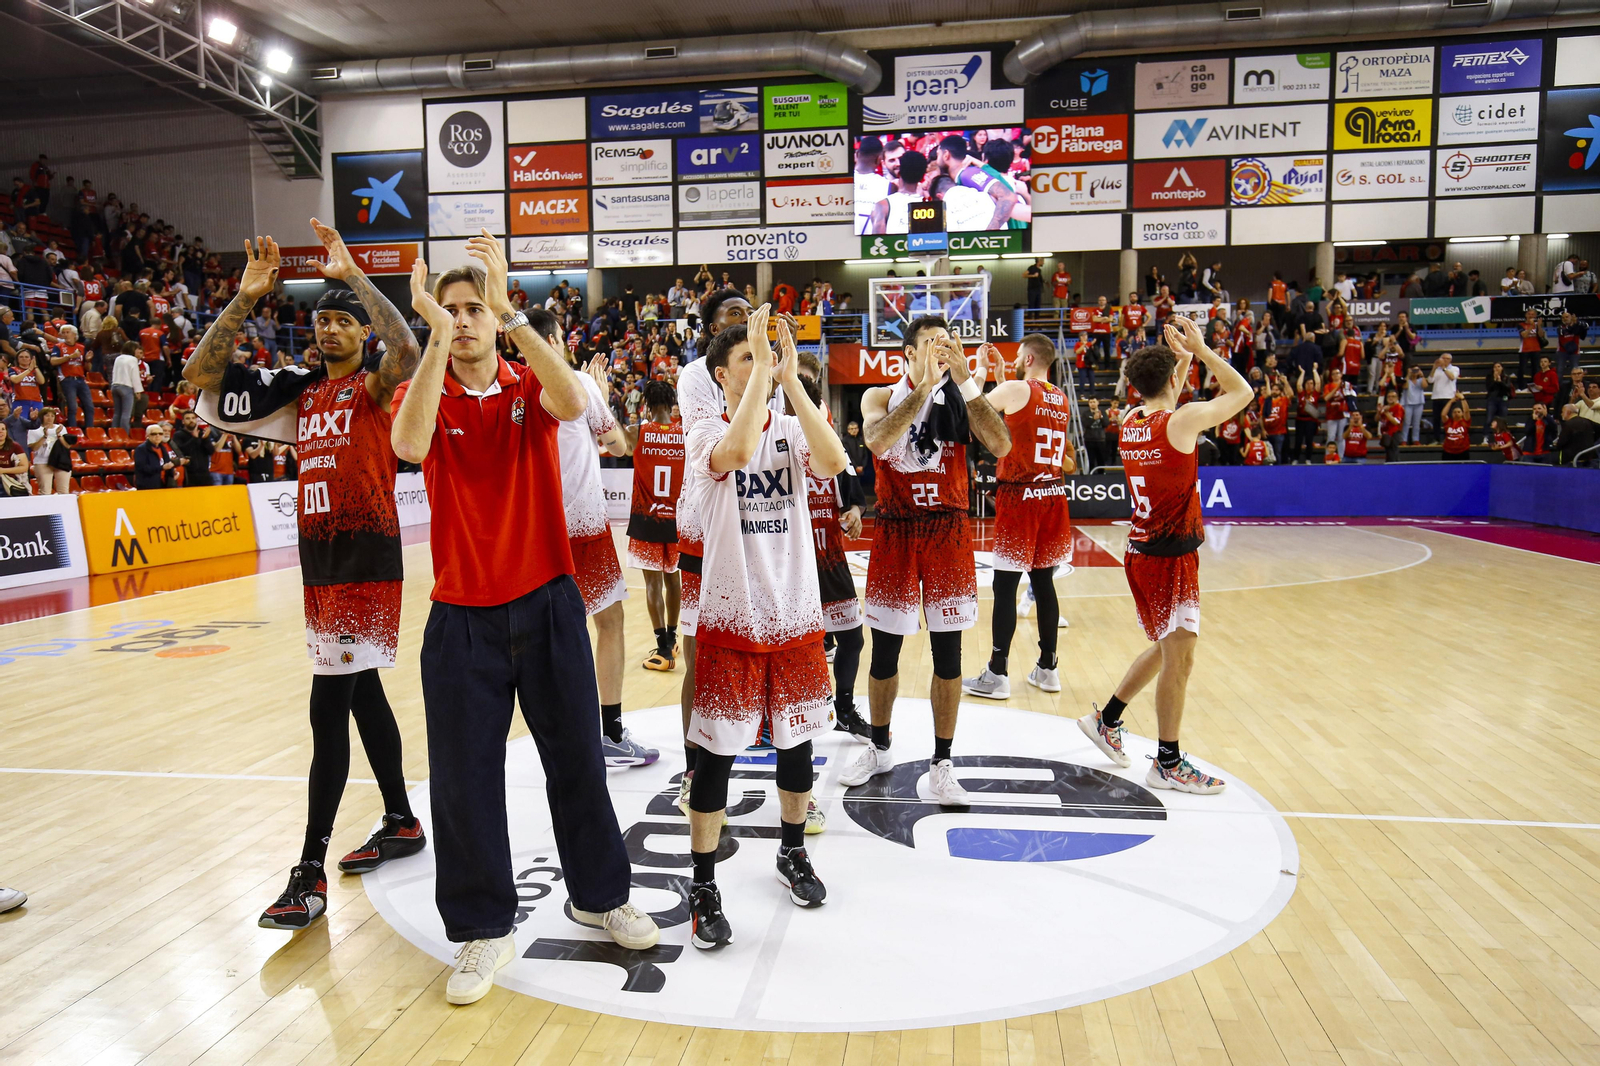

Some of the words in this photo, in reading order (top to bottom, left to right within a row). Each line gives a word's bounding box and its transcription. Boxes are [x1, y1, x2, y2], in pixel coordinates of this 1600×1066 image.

[1362, 53, 1430, 66] ORTOPÈDIA
[1453, 51, 1509, 68] PENTEX
[907, 69, 958, 77] DISTRIBUIDORA
[1191, 64, 1206, 73] ca
[1379, 69, 1412, 78] MAZA
[1191, 73, 1214, 81] non
[905, 78, 958, 102] joan
[1191, 82, 1206, 93] ge
[774, 96, 809, 104] BUSQUEM
[908, 100, 1015, 113] www.grupjoan.com
[1050, 98, 1088, 108] CUBE
[601, 102, 693, 118] Sagalés
[1478, 103, 1525, 120] cidet
[450, 124, 482, 141] Ros
[608, 119, 686, 133] www.sagales.com
[1061, 125, 1104, 138] Plana
[1207, 121, 1301, 142] AVINENT
[767, 133, 844, 149] JUANOLA
[778, 161, 814, 169] expert
[1474, 153, 1531, 163] SHOOTER
[620, 160, 668, 173] simplifica
[514, 168, 560, 182] Halcón
[560, 171, 583, 181] viajes
[1359, 175, 1370, 185] S.
[1377, 173, 1405, 184] GOL
[1031, 171, 1087, 193] GCT
[1090, 176, 1122, 198] plus
[1445, 183, 1526, 192] WWW.SHOOTERPADEL.COM
[611, 194, 670, 204] santasusana
[1152, 188, 1206, 202] montepio
[519, 199, 579, 216] NACEX
[1143, 220, 1199, 230] movento
[598, 236, 669, 247] Sagalés
[727, 230, 807, 247] movento
[1143, 230, 1178, 240] sarsa
[949, 236, 1011, 251] CLARET
[372, 249, 400, 257] Catalana
[372, 256, 400, 264] Occident
[727, 246, 778, 261] sarsa
[1353, 245, 1419, 261] BAR
[280, 254, 332, 267] ESTRELL
[86, 282, 100, 295] 98
[155, 302, 168, 314] 98
[1413, 306, 1460, 316] UMANRESA
[224, 391, 251, 416] 00
[298, 409, 353, 442] BAXI
[1122, 426, 1151, 443] GARCÍA
[642, 445, 684, 459] inmoovs
[1034, 427, 1066, 467] 23
[654, 465, 671, 497] 0
[735, 467, 793, 499] BAXI
[911, 483, 942, 507] 22
[1066, 479, 1125, 501] desa
[304, 481, 331, 515] 00
[147, 511, 241, 544] mutuacat
[742, 518, 789, 535] MANRESA
[0, 531, 53, 561] Bank
[814, 527, 827, 551] 11
[830, 611, 846, 620] ETL
[942, 607, 960, 617] ETL
[789, 714, 808, 728] ETL
[791, 721, 823, 738] GLOBAL
